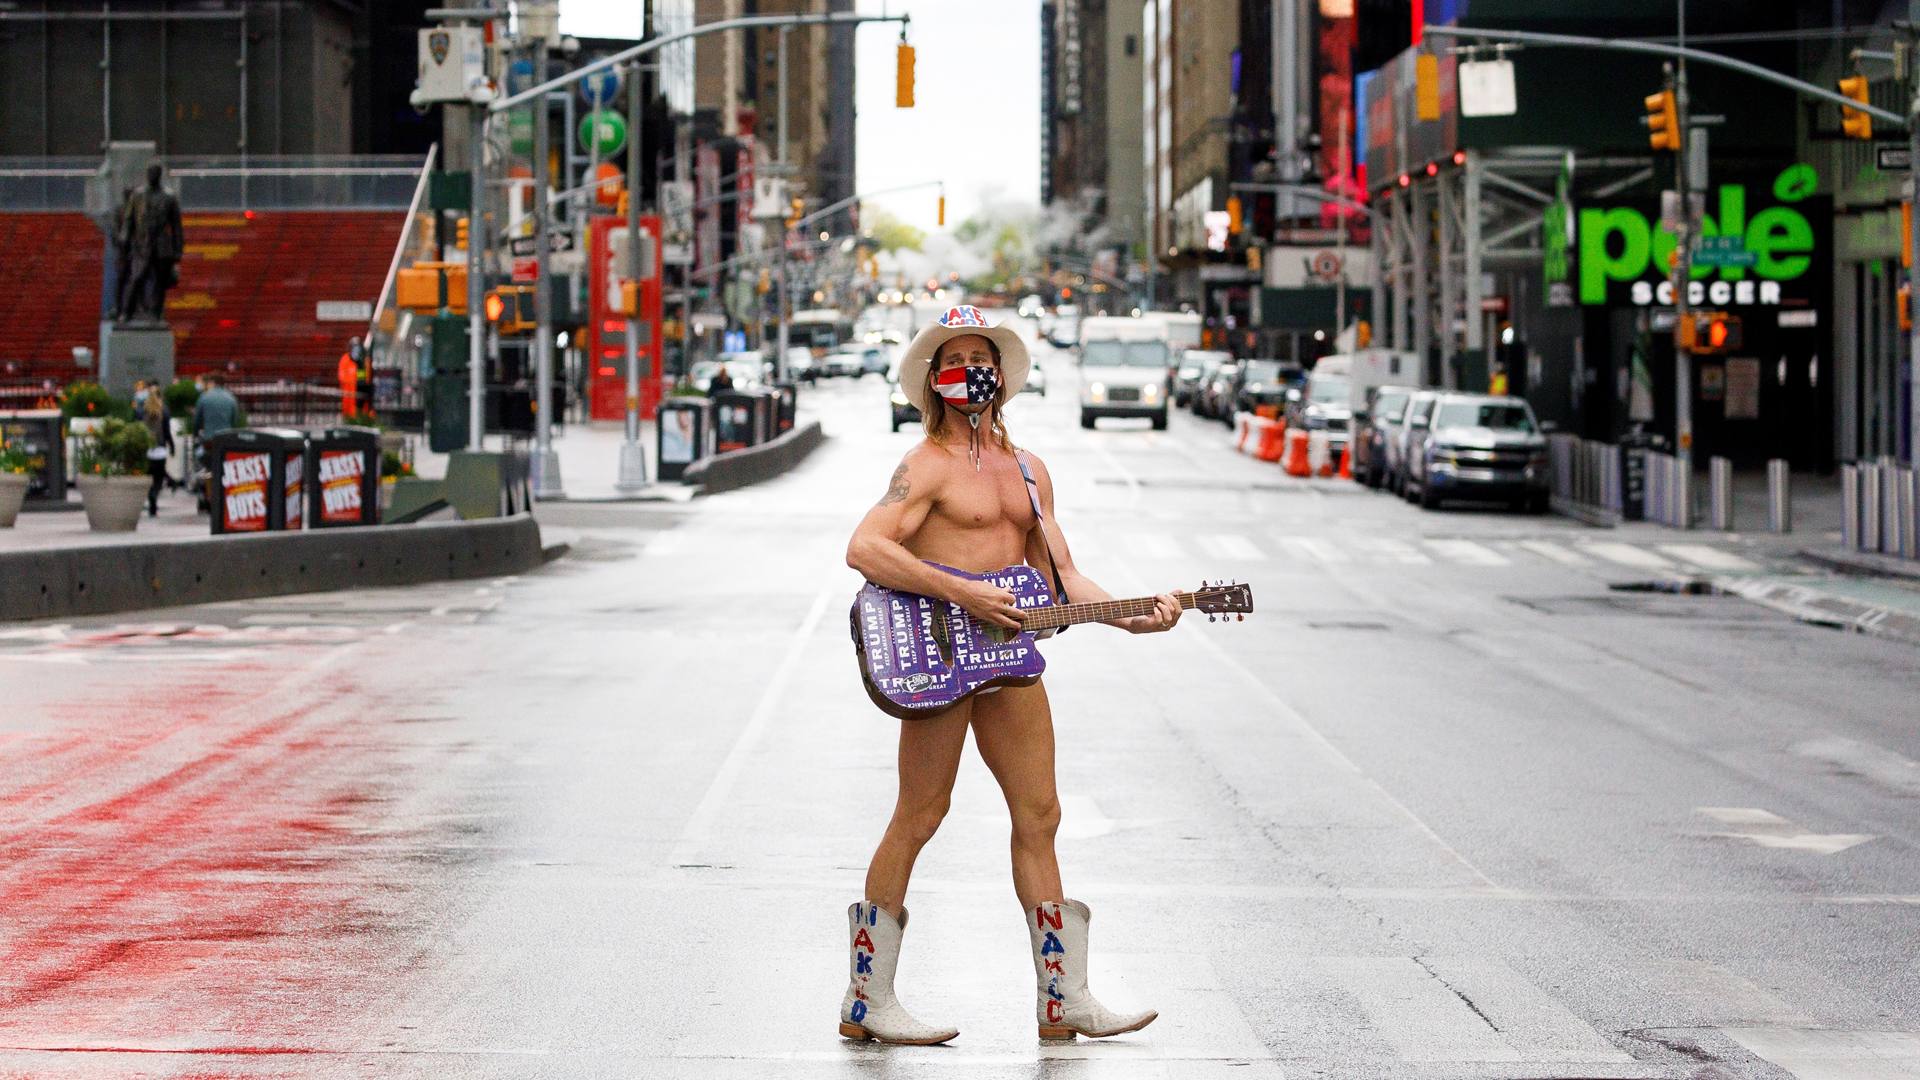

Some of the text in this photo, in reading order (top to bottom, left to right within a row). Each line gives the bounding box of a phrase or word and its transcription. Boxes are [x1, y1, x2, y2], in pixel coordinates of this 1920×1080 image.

[1631, 280, 1780, 306] SOCCER
[939, 307, 988, 326] NAKE
[222, 453, 271, 488] JERSEY
[318, 451, 365, 483] JERSEY
[226, 489, 266, 523] BOYS
[323, 483, 361, 515] BOYS
[865, 601, 885, 673] TRUMP
[880, 626, 889, 652] AMERICA
[892, 599, 912, 671] TRUMP
[904, 605, 918, 664] KEEP AMERICA GREAT
[950, 602, 969, 659] TRUM
[956, 648, 1028, 665] TRUMP
[879, 673, 952, 689] TRP
